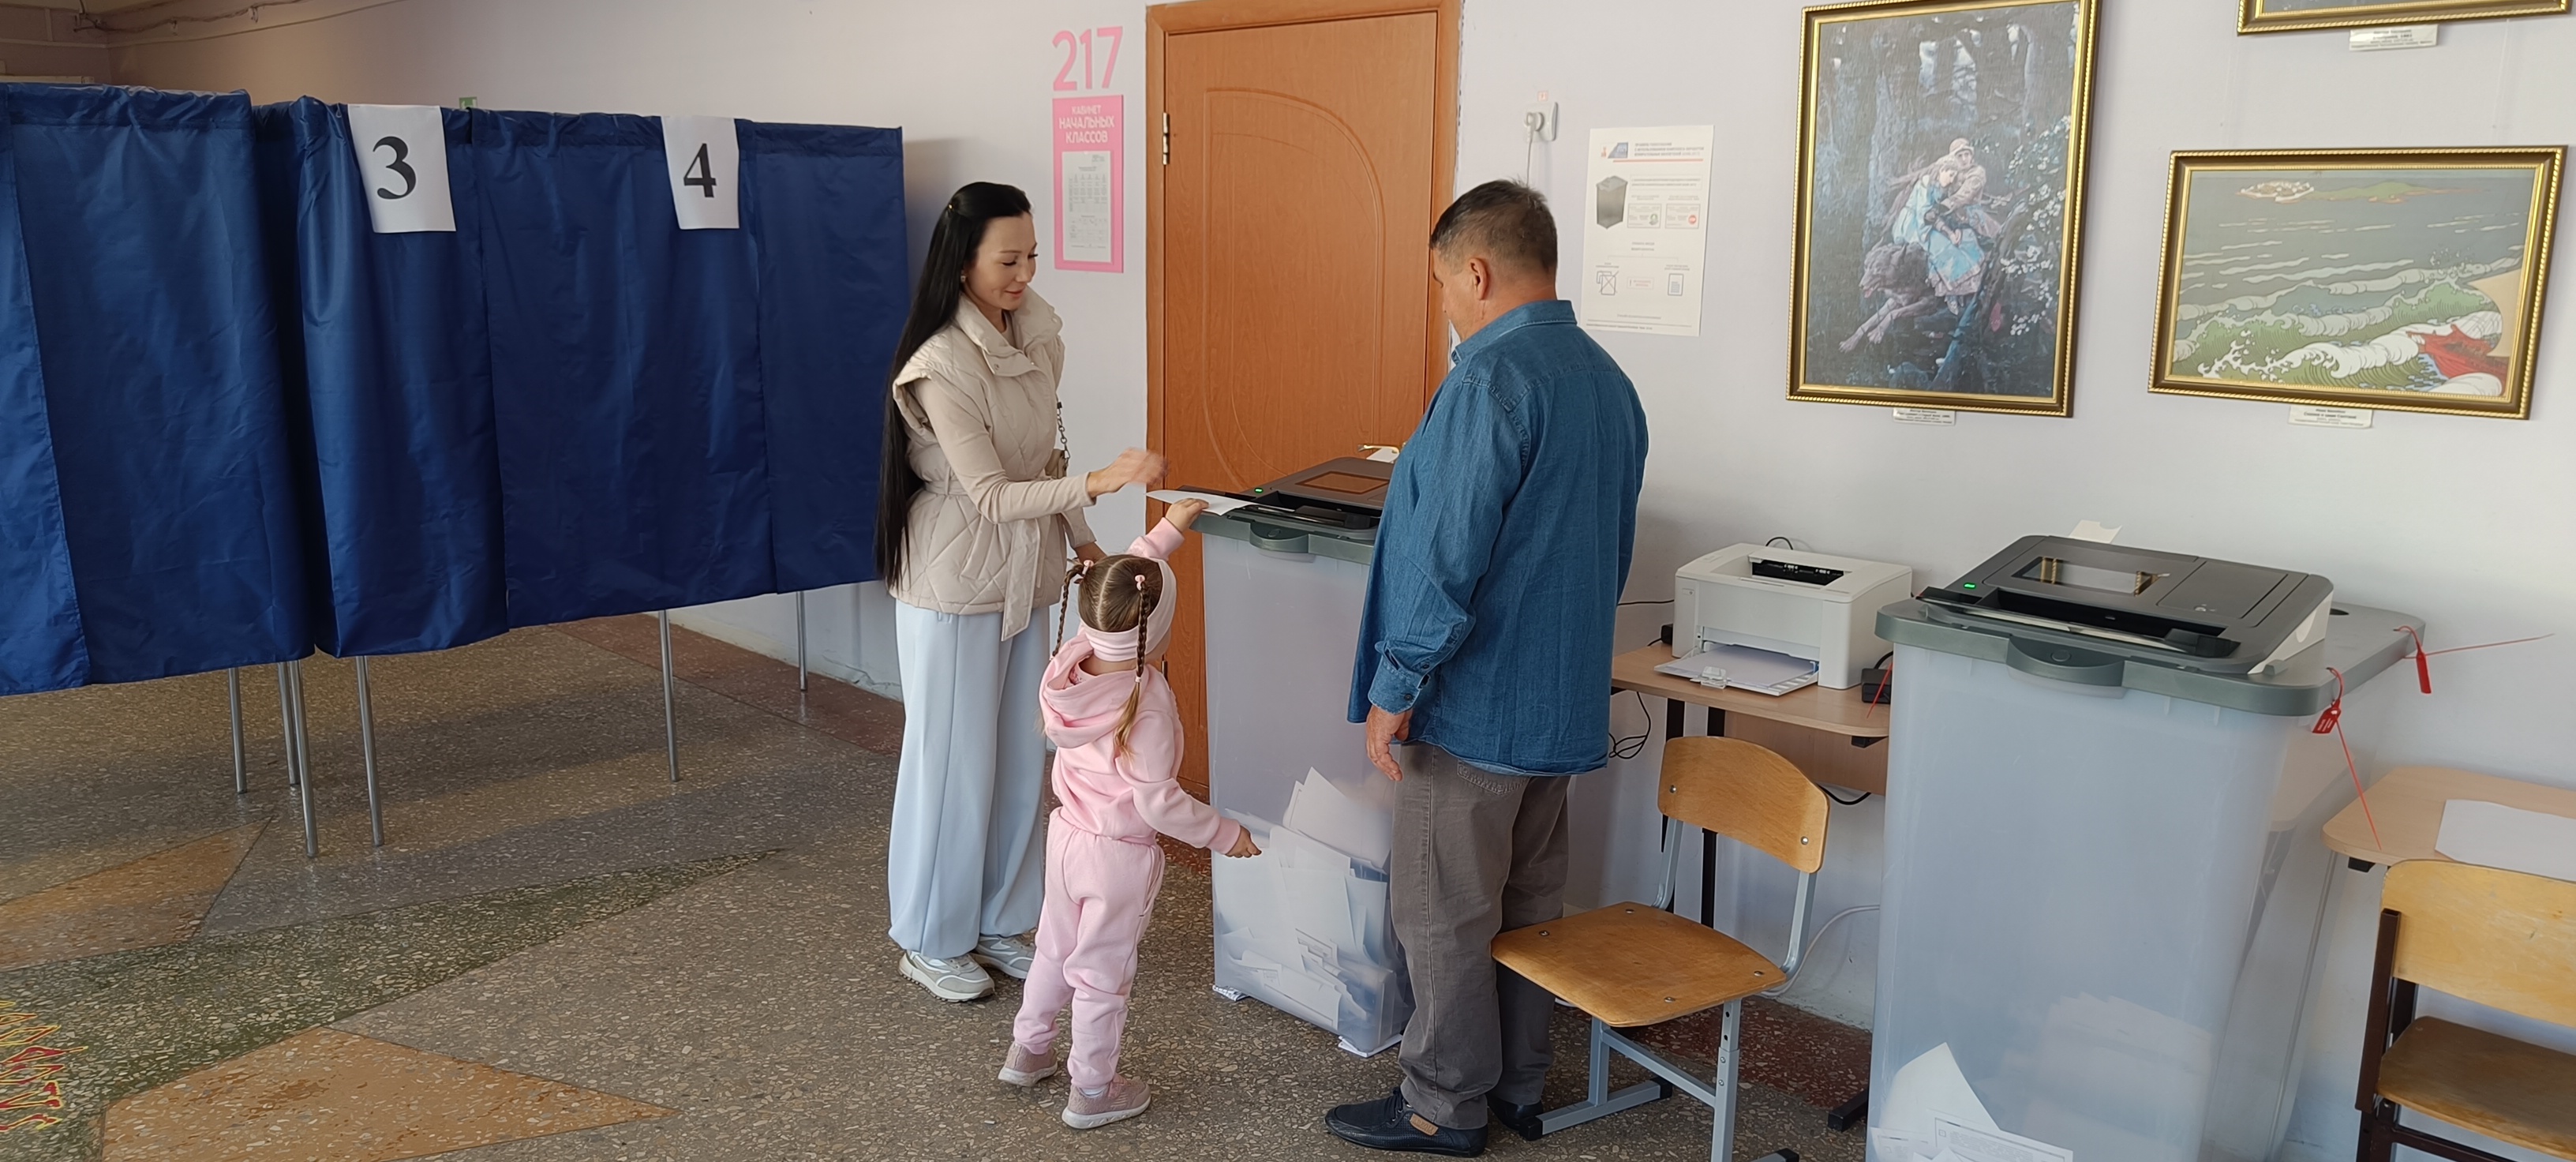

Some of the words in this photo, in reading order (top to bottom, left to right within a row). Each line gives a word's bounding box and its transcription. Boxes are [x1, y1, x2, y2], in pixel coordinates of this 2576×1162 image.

[1052, 26, 1123, 91] 217
[1058, 115, 1115, 129] НАЧАЛЬНЫХ
[1065, 130, 1108, 144] КЛАССОВ
[373, 136, 417, 200] 3
[683, 143, 717, 198] 4
